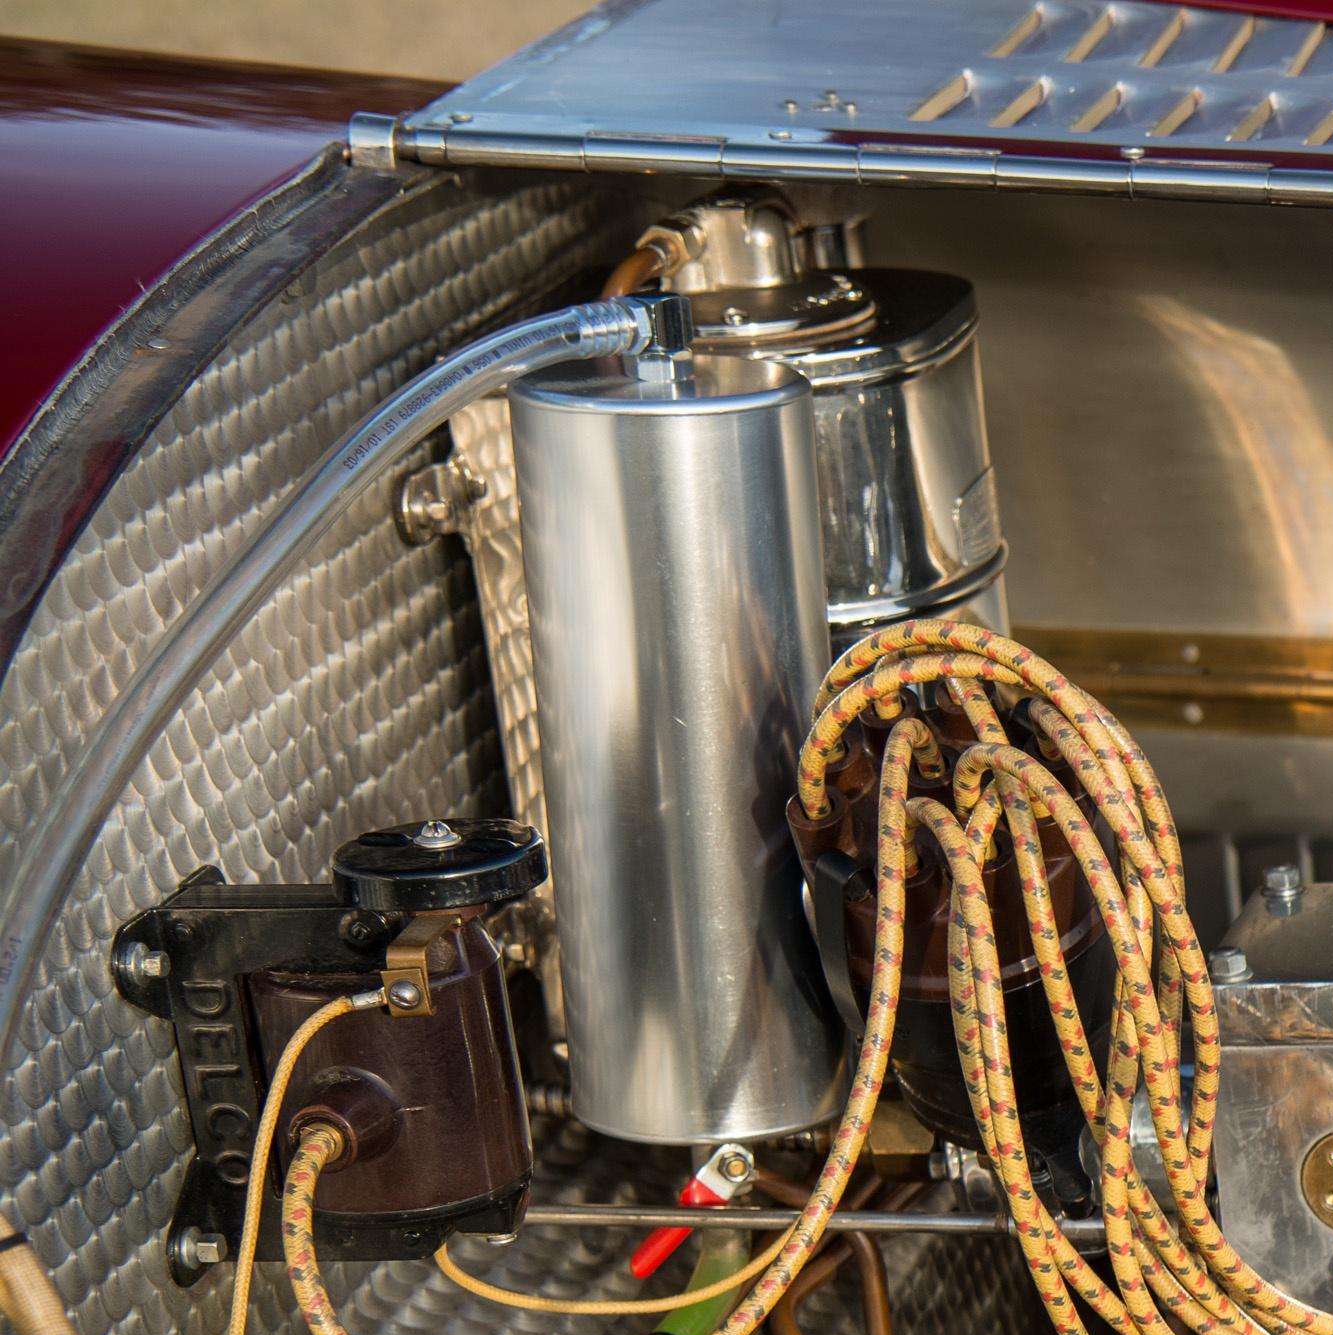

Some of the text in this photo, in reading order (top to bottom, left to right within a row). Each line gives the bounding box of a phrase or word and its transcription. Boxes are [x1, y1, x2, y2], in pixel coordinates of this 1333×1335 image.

[473, 354, 490, 370] 056
[343, 432, 382, 470] 10/16/03
[182, 978, 250, 1185] DELCO
